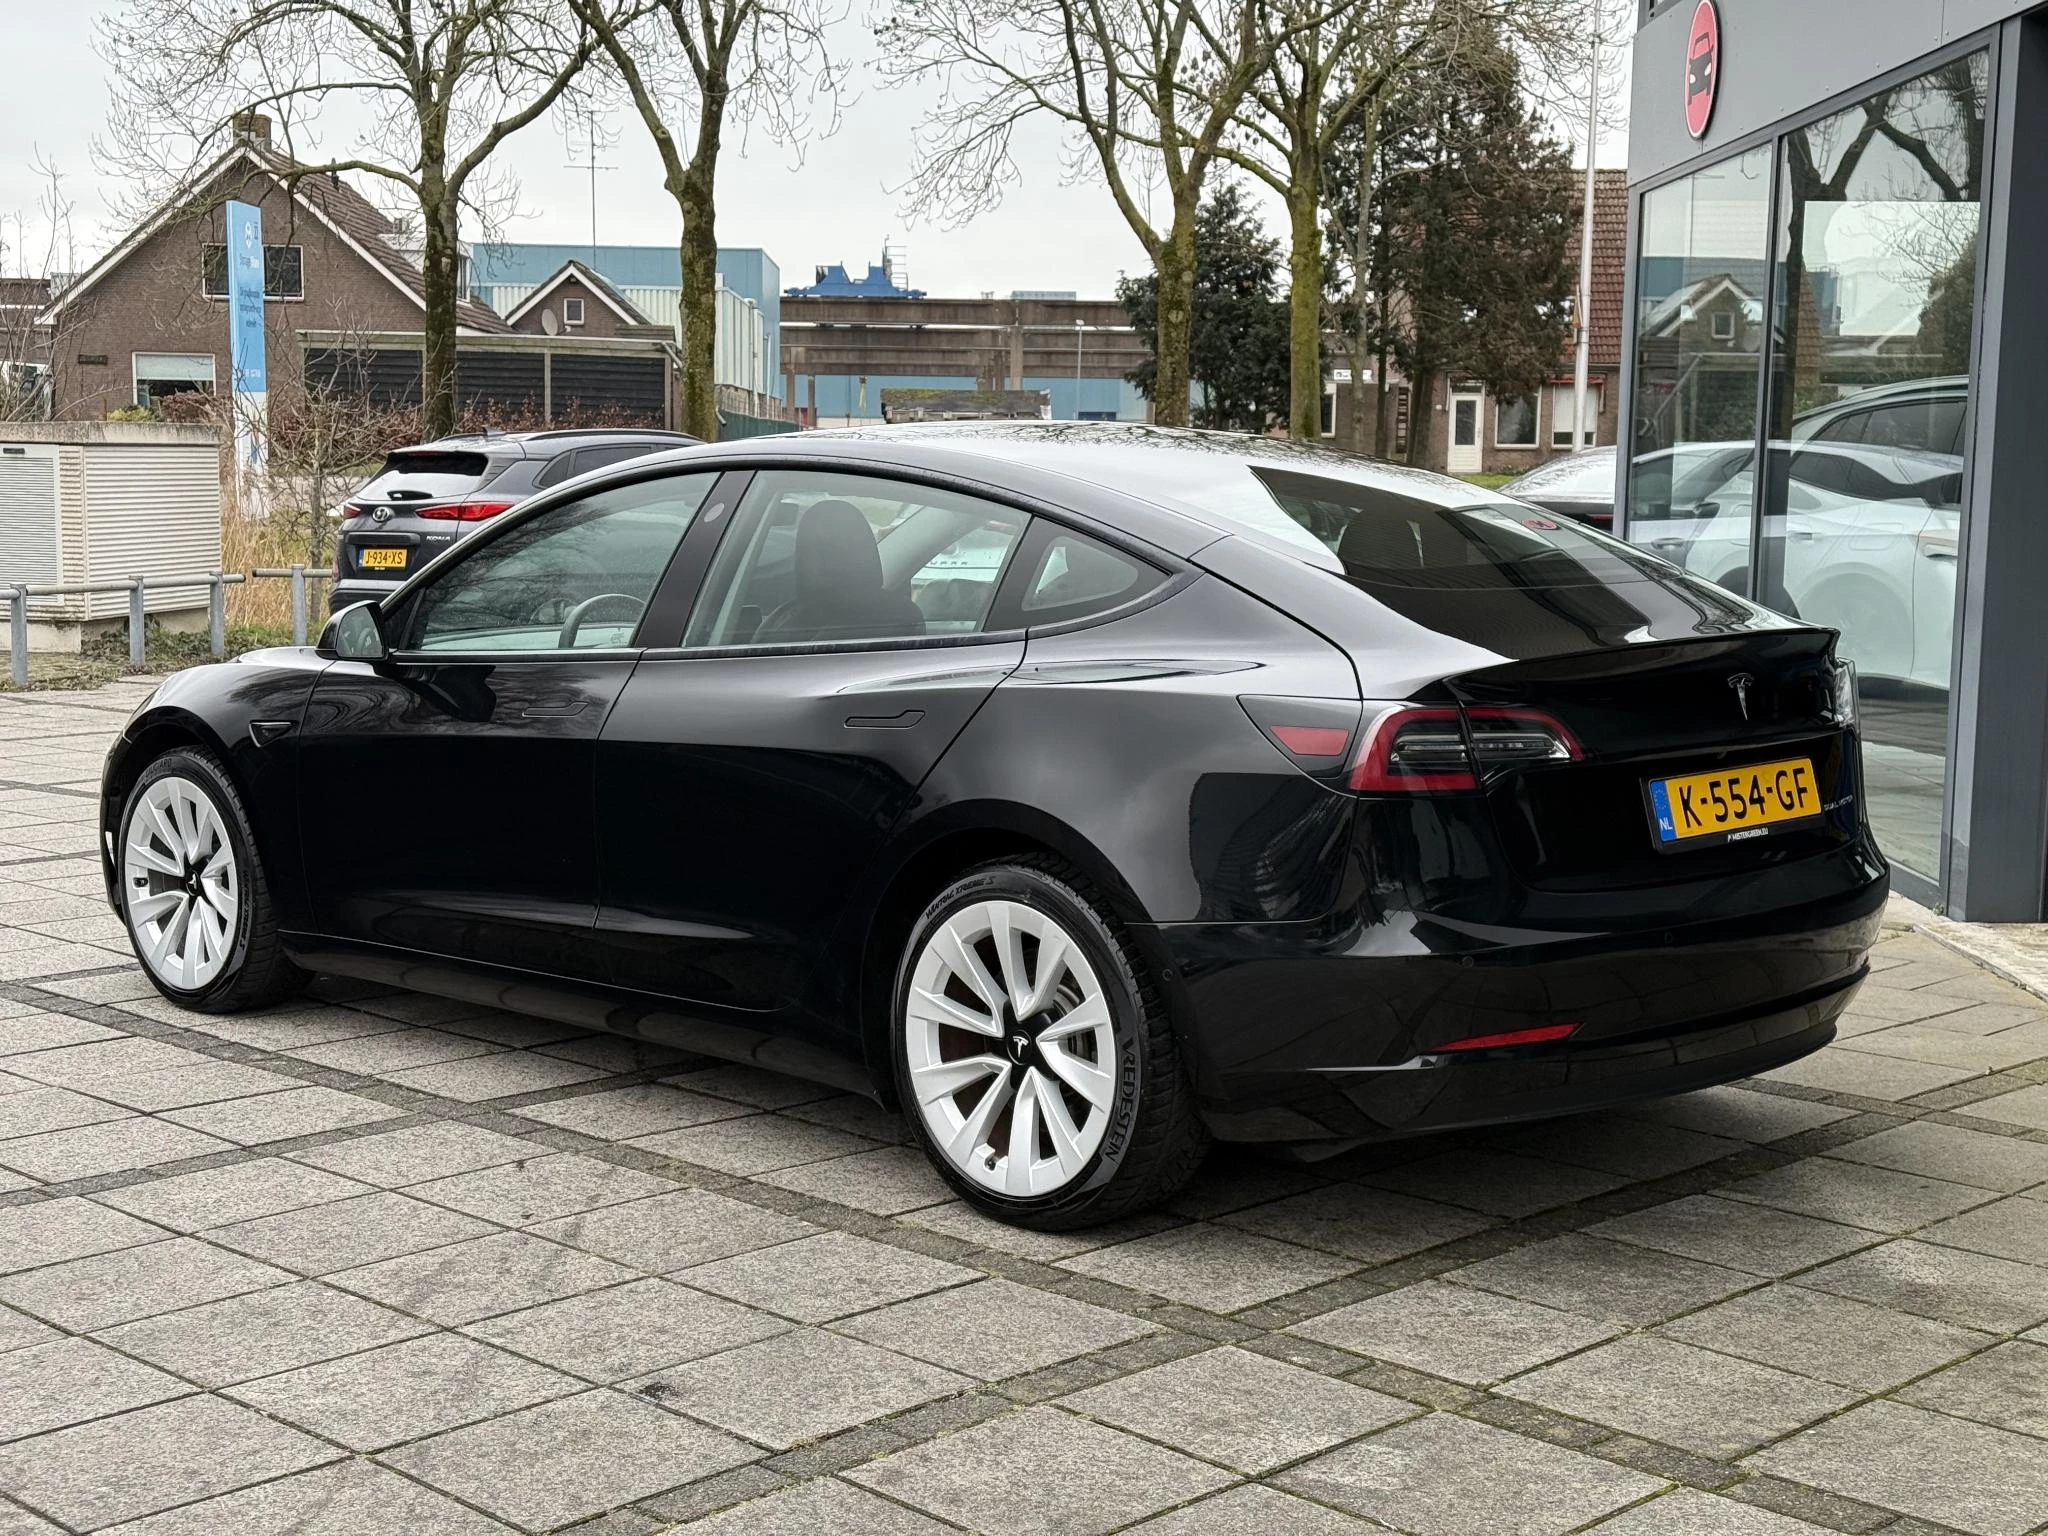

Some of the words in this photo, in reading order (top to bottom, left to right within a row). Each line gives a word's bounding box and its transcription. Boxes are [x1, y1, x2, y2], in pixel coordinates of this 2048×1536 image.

[365, 551, 403, 565] J-934-XS
[1678, 767, 1808, 828] K-554-GF
[1659, 817, 1673, 831] NL
[1104, 1036, 1136, 1165] VREDESTEIN
